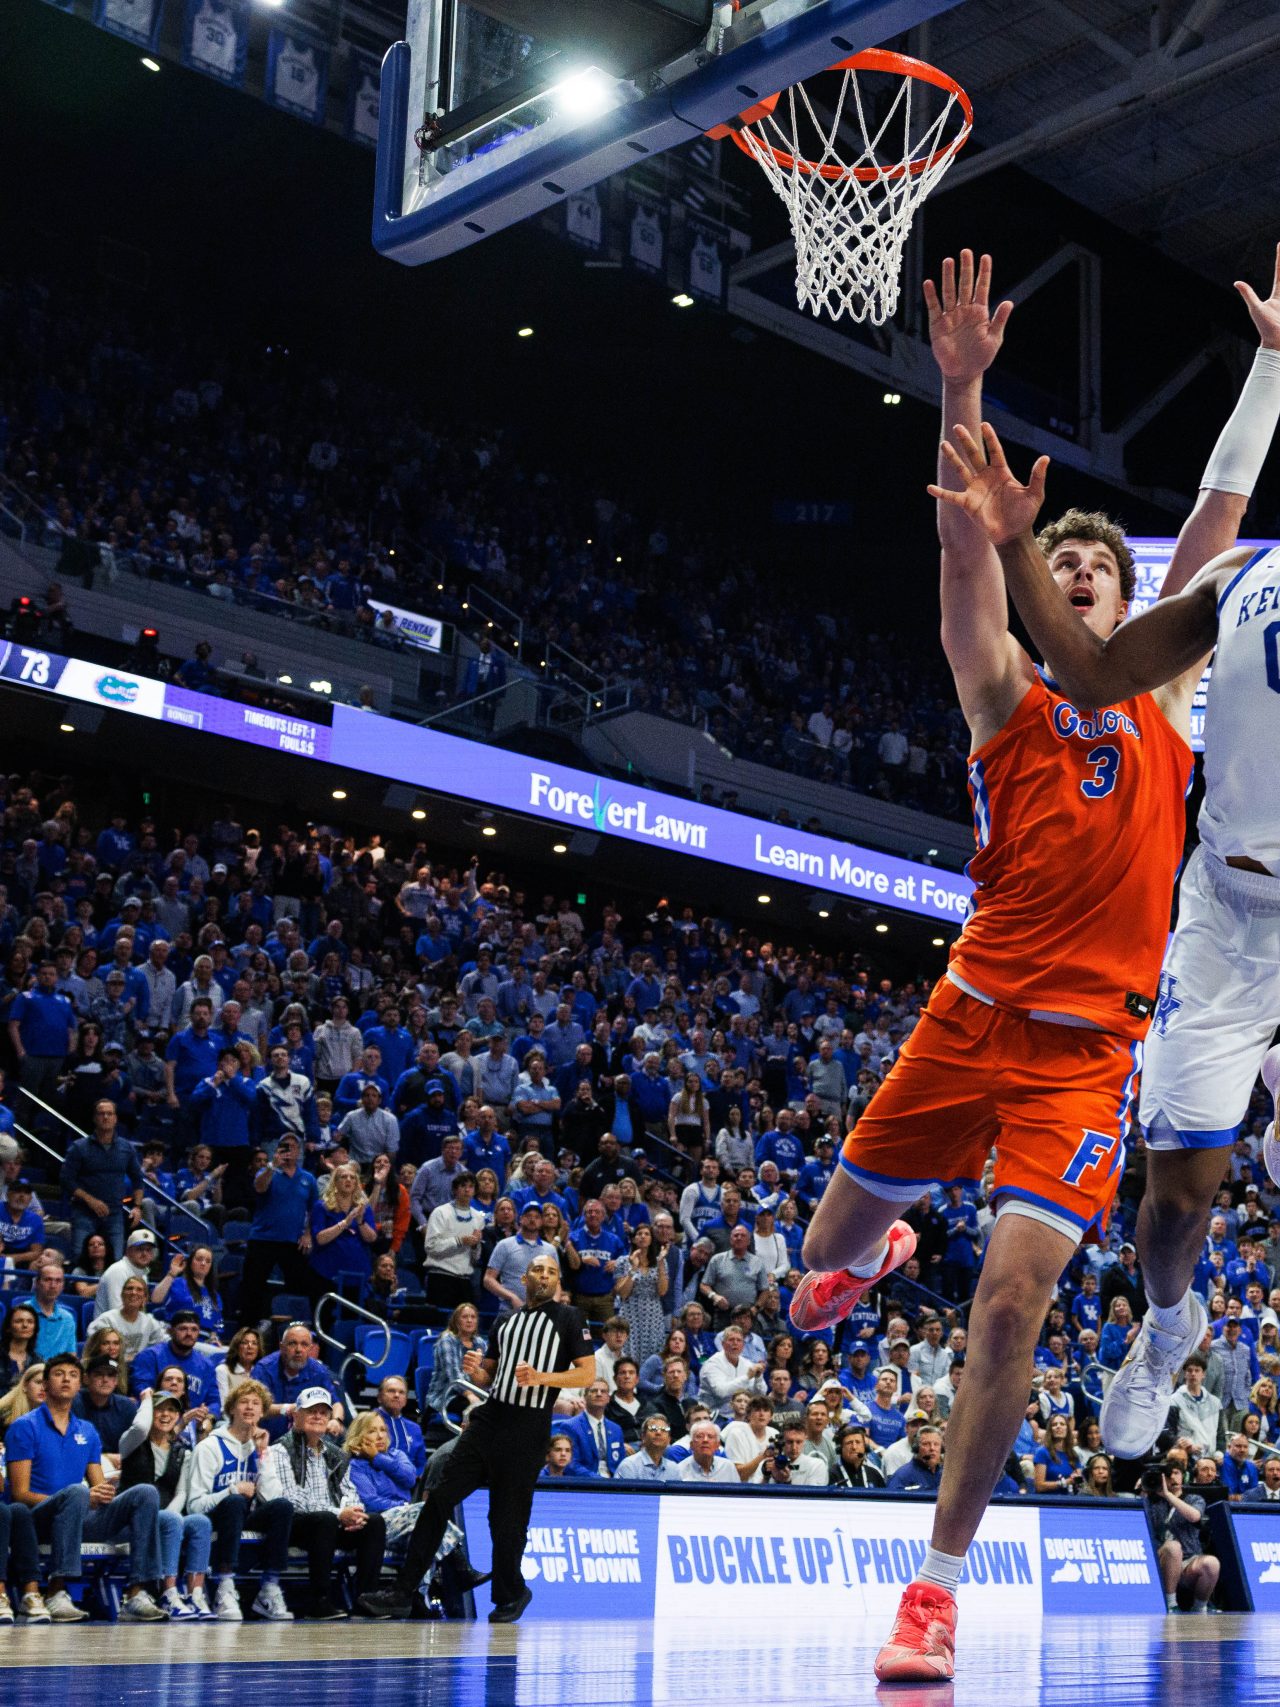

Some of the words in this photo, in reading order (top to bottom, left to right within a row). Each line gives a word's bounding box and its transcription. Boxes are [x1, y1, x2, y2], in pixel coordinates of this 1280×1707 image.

[20, 648, 51, 685] 73
[243, 709, 288, 733] TIMEOUTS
[1080, 745, 1121, 799] 3
[754, 834, 824, 878] Learn
[829, 857, 889, 894] More
[893, 874, 918, 902] at
[1058, 1127, 1118, 1187] F
[577, 1528, 640, 1555] PHONE
[1044, 1537, 1097, 1560] BUCKLE
[1102, 1539, 1148, 1561] PHONE
[541, 1556, 569, 1583] UP
[581, 1557, 642, 1584] DOWN
[667, 1534, 796, 1585] BUCKLE
[793, 1536, 834, 1585] UP
[1081, 1562, 1100, 1584] UP
[1107, 1563, 1151, 1585] DOWN
